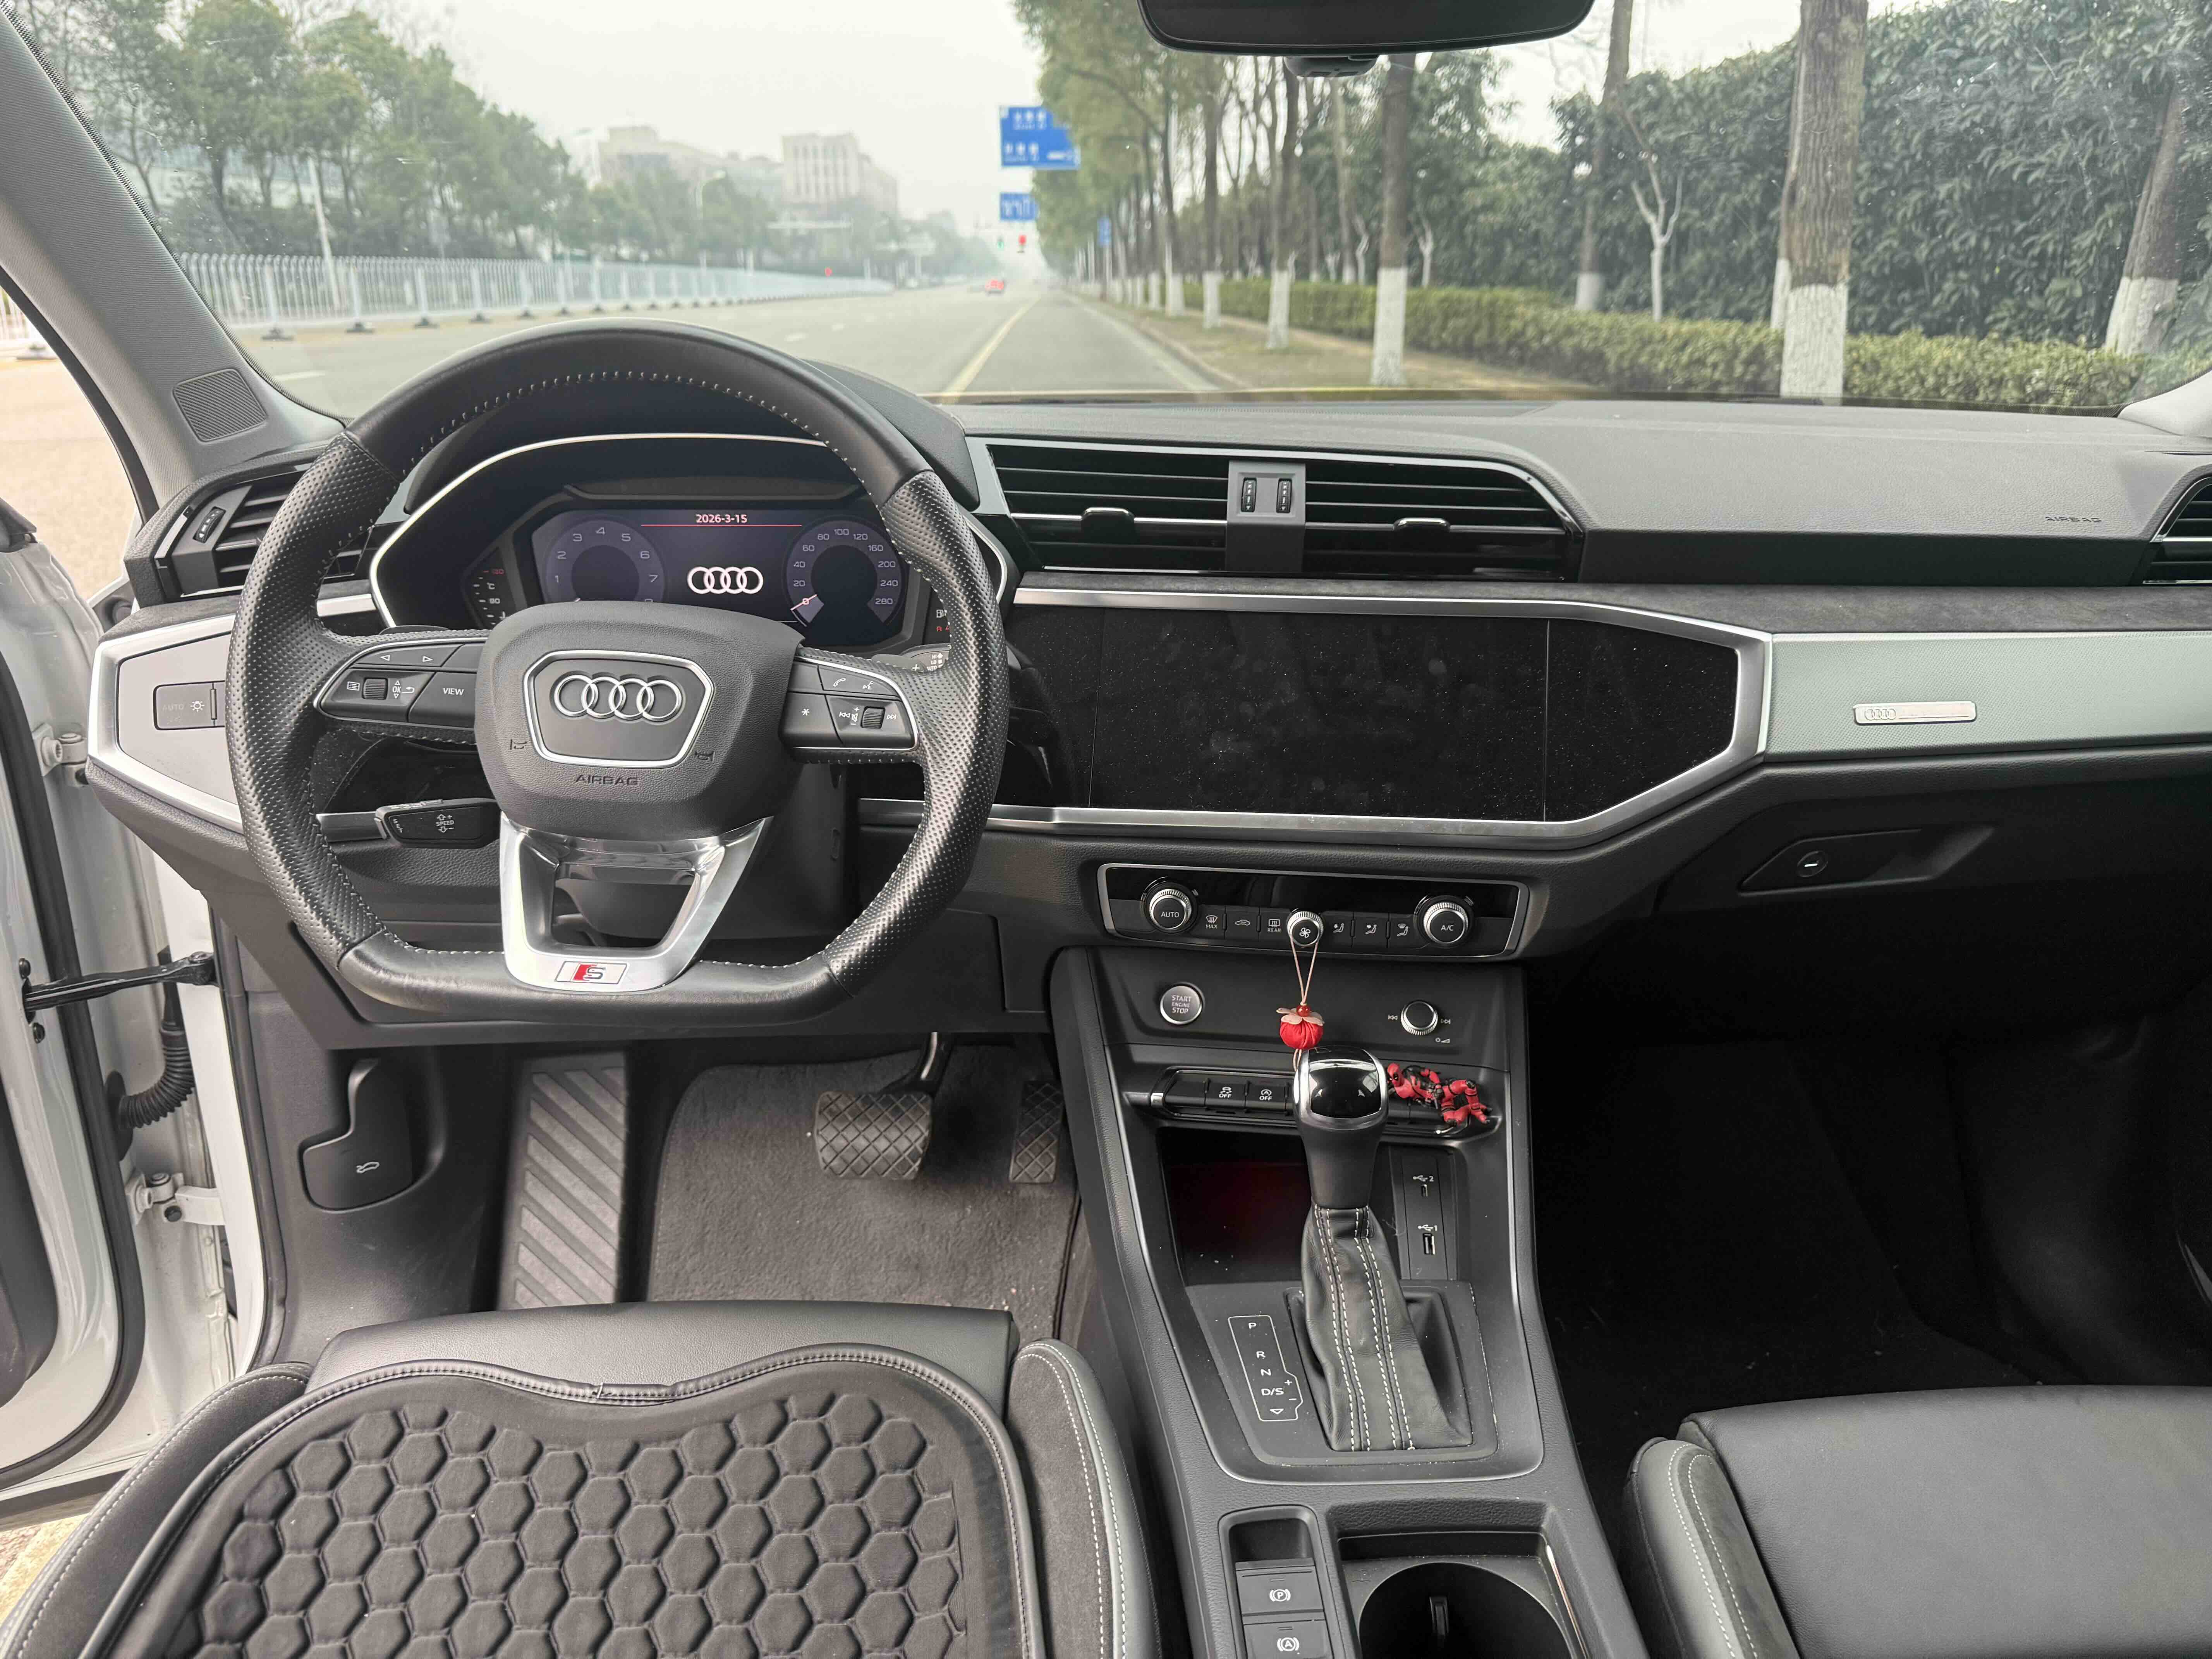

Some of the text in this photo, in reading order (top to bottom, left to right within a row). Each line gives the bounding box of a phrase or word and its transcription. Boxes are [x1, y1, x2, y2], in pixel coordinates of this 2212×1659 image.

[696, 514, 747, 523] 2026-3-15
[596, 527, 606, 535] 4
[573, 533, 582, 542] 3
[621, 533, 631, 542] 5
[557, 551, 567, 560] 2
[640, 551, 650, 559] 6
[555, 575, 559, 583] 1
[649, 575, 658, 583] 7
[575, 774, 639, 786] AIRBAG
[393, 819, 404, 833] SET
[1261, 1388, 1285, 1396] D/S
